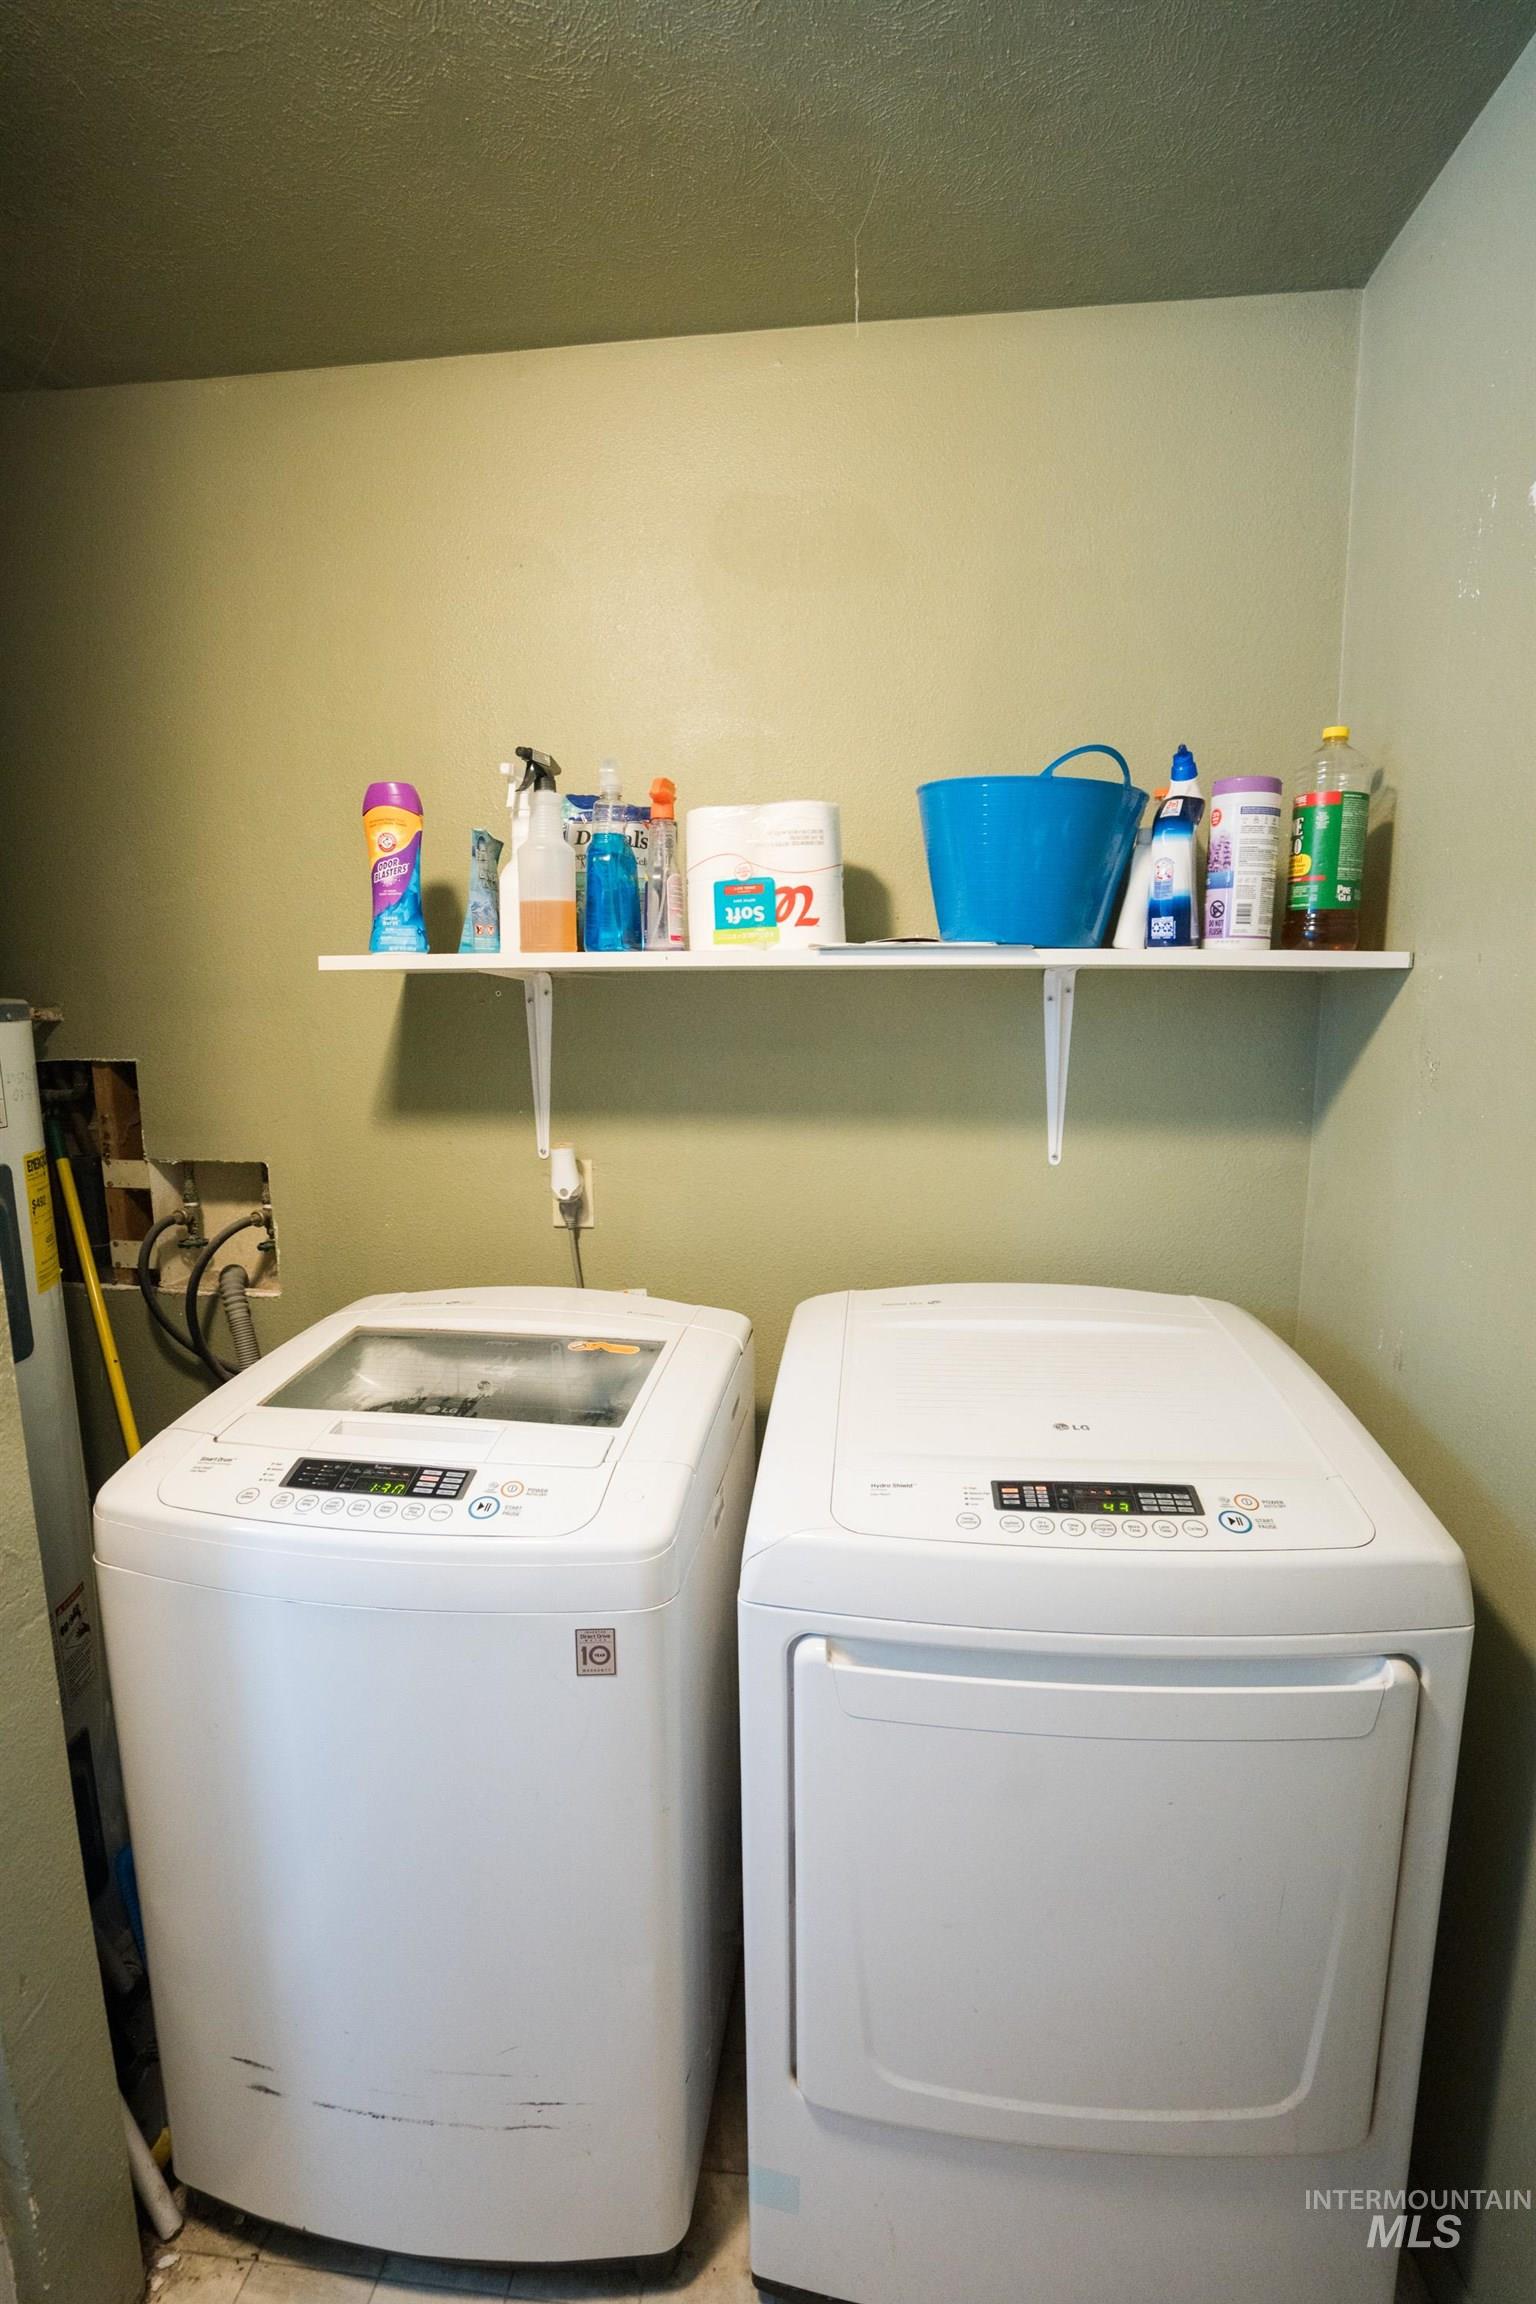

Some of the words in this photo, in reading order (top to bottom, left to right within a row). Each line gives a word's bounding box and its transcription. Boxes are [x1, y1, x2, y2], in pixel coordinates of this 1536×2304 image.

[374, 865, 407, 882] BLASTERS
[378, 858, 399, 872] ODOR
[725, 905, 766, 924] Soft
[581, 1645, 611, 1666] 10
